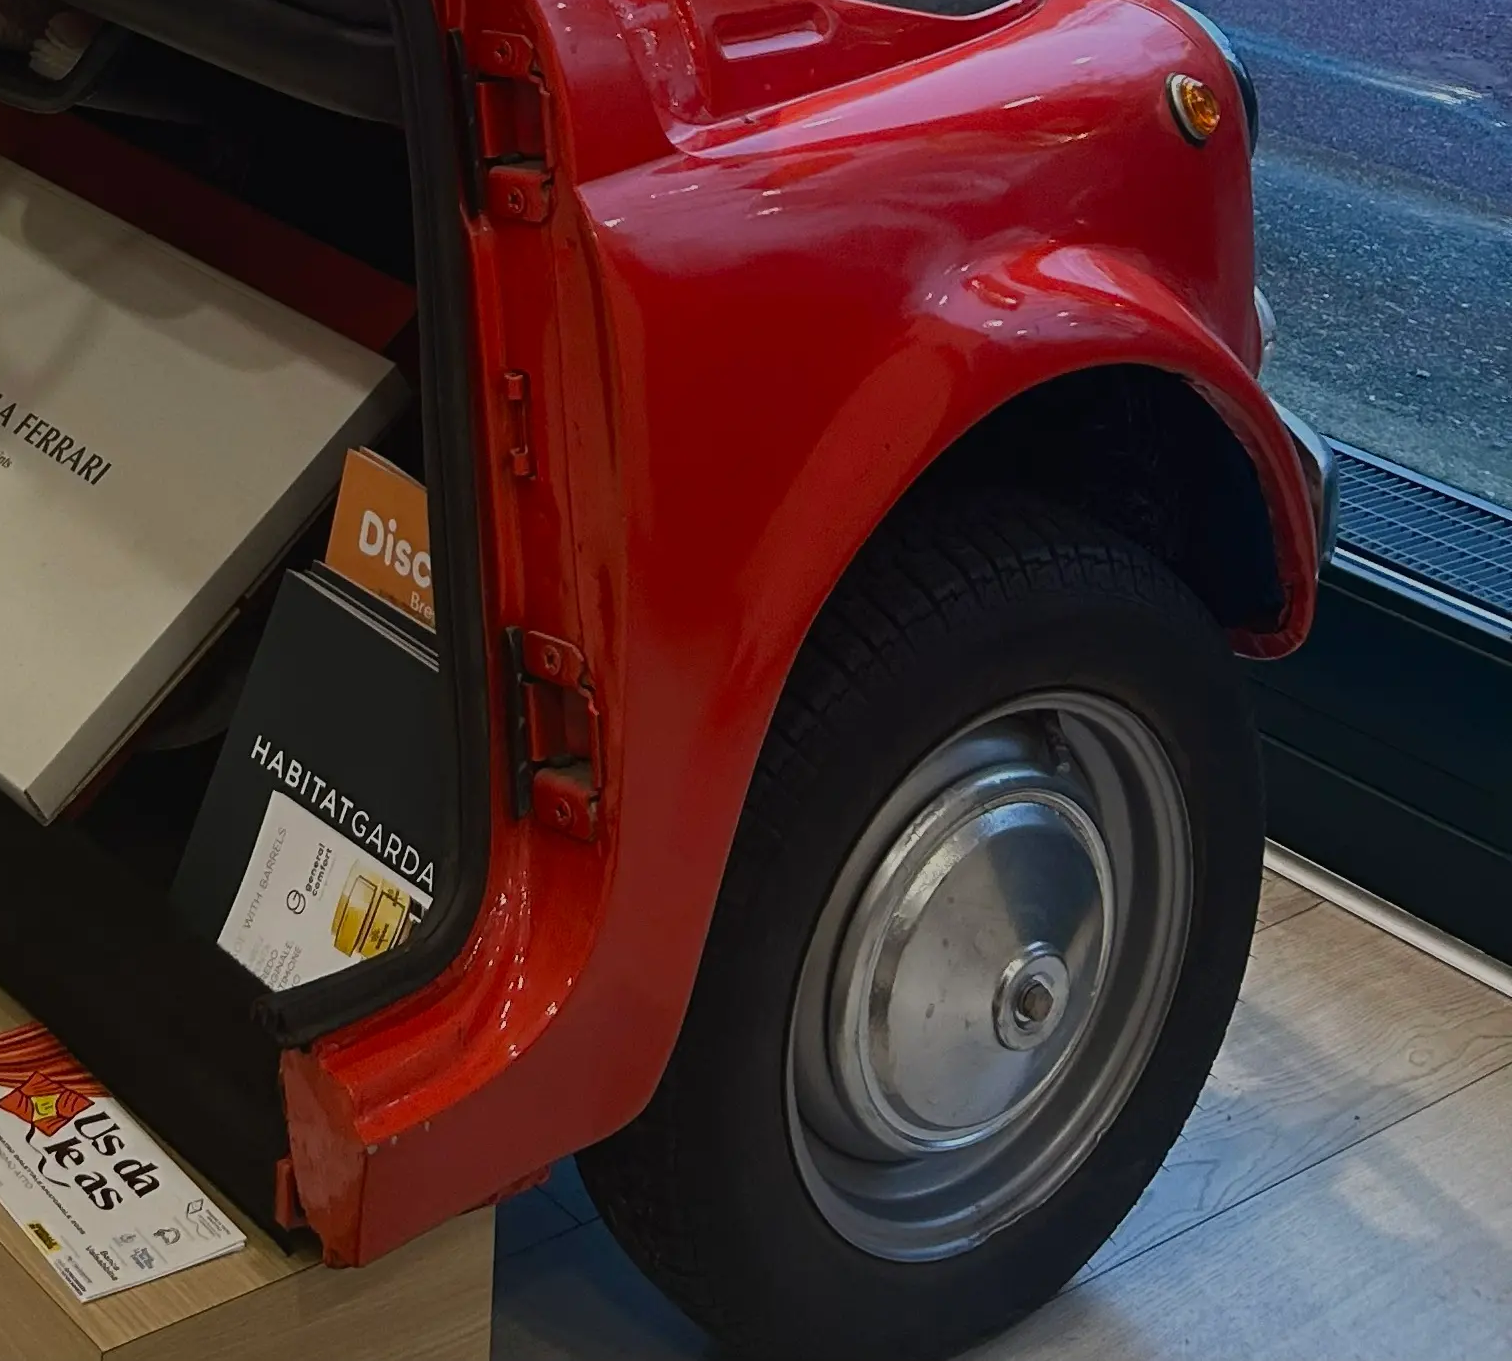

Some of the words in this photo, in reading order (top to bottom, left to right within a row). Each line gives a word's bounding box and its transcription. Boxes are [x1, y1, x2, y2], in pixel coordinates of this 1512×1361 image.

[13, 412, 113, 485] FERRARI
[358, 510, 432, 589] Disc
[250, 734, 435, 894] HABITATGARDA
[243, 893, 263, 929] WITH
[259, 827, 287, 890] BARRELS
[305, 842, 326, 892] general
[312, 848, 333, 897] comfort
[43, 1136, 85, 1169] le
[75, 1171, 124, 1211] as
[75, 1112, 125, 1157] Us
[114, 1158, 161, 1198] da
